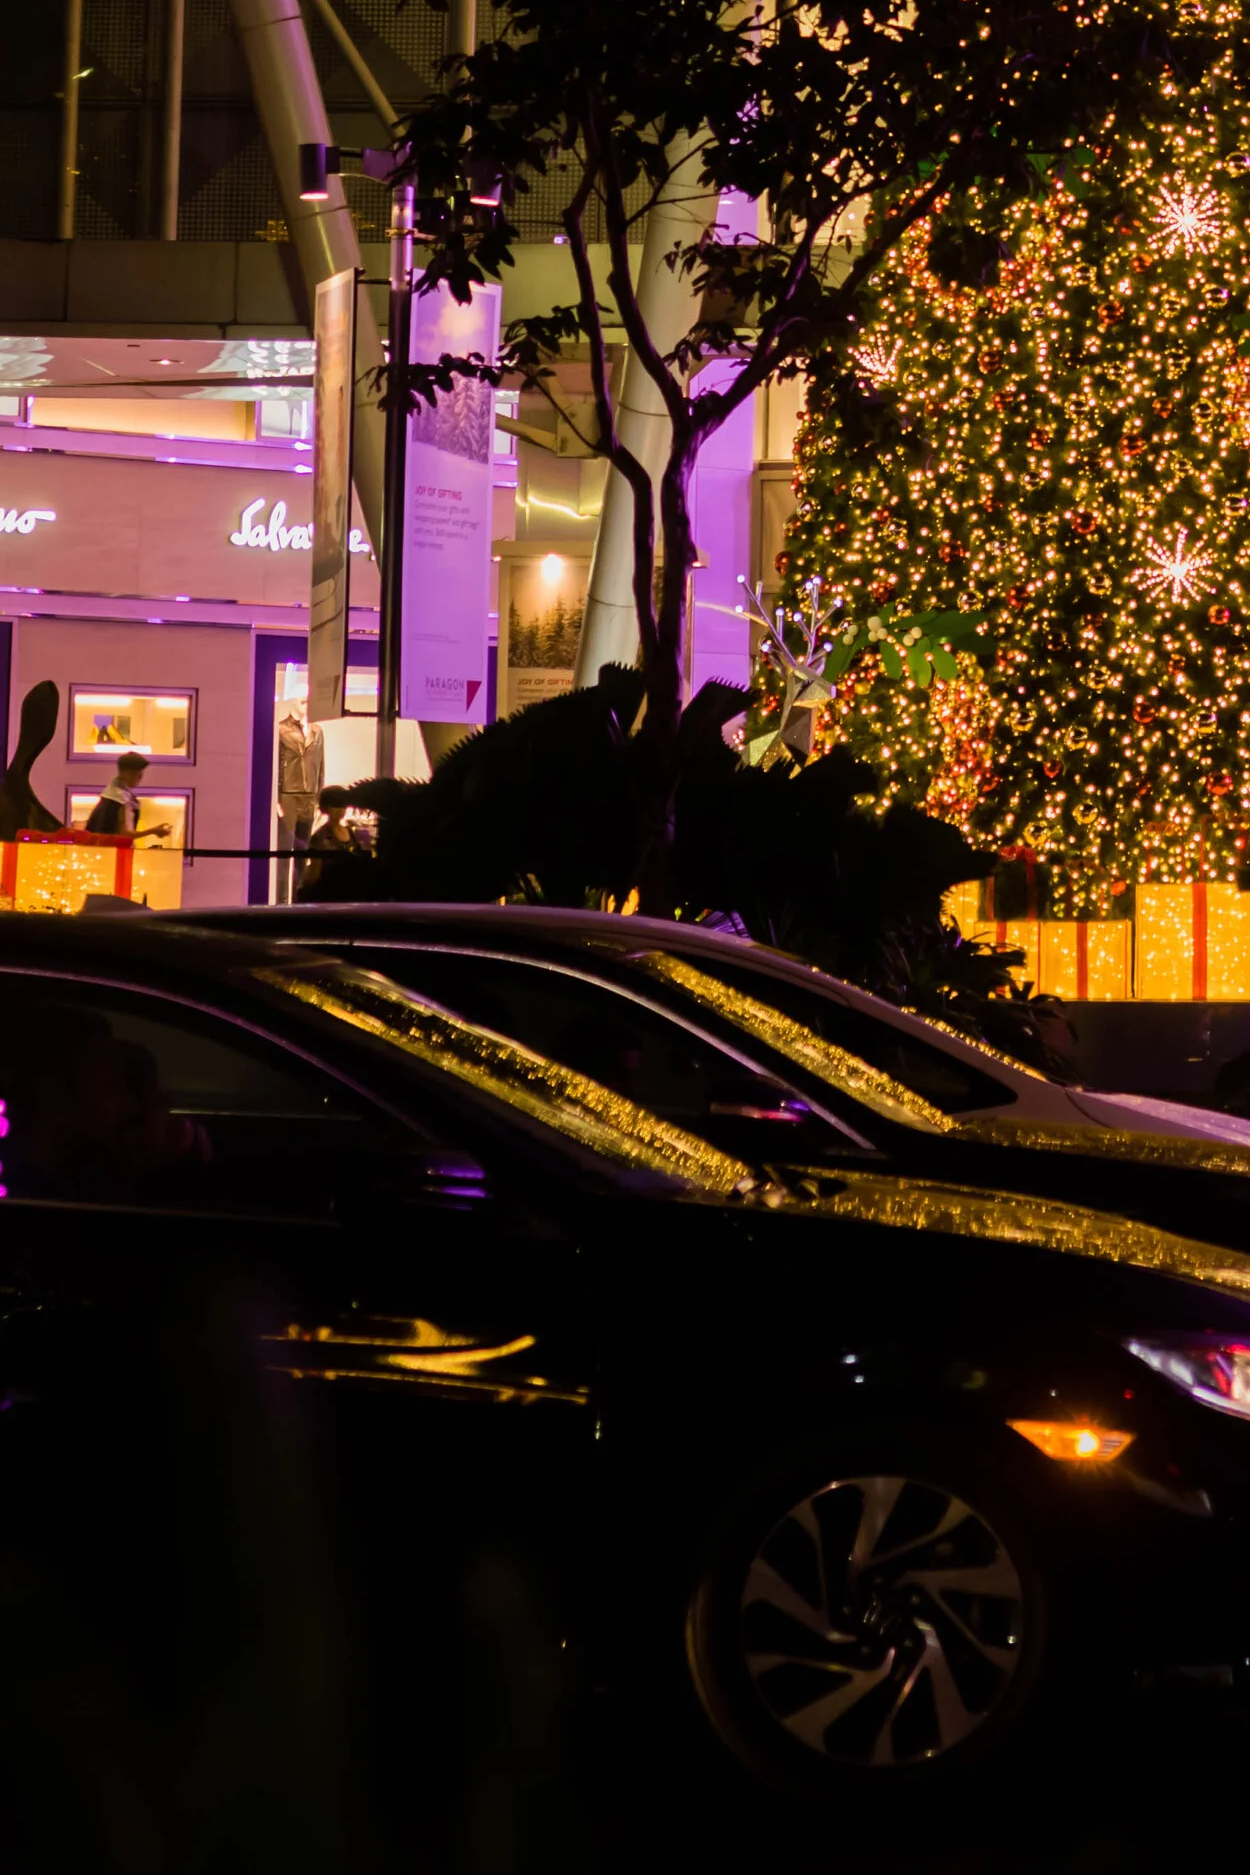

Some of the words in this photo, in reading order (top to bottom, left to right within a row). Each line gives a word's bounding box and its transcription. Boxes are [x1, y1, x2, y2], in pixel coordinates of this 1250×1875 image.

[415, 485, 426, 496] JOY
[427, 487, 437, 497] OF
[438, 488, 463, 501] GIFTING
[425, 676, 464, 691] PARAGON
[518, 678, 533, 686] JOY
[534, 678, 545, 686] OF
[547, 678, 575, 686] GIFTIN
